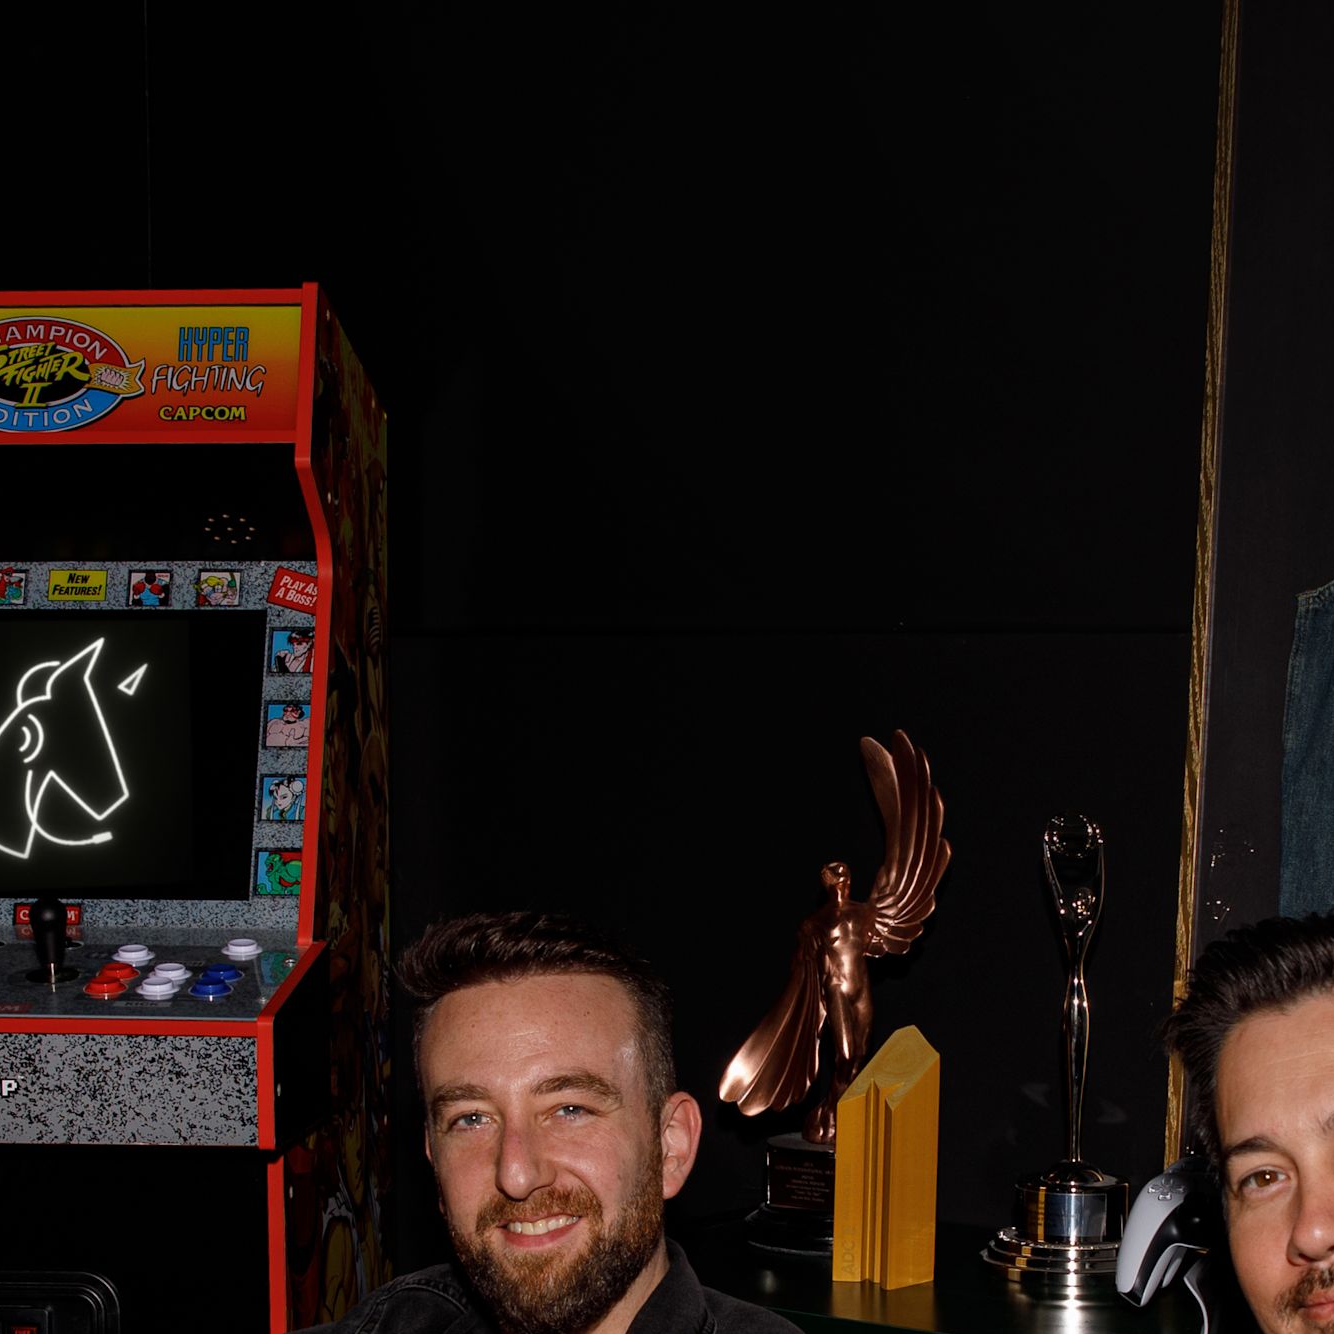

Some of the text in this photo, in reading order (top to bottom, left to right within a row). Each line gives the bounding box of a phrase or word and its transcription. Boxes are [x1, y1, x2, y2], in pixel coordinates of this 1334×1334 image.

[178, 327, 249, 362] HYPER
[150, 364, 267, 397] FIGHTING
[15, 382, 54, 408] II
[159, 405, 247, 421] CAPCOM
[67, 573, 90, 585] NEW
[279, 575, 318, 596] PLAY AS
[52, 584, 102, 596] FEATURES!
[275, 587, 317, 607] A BOSS!
